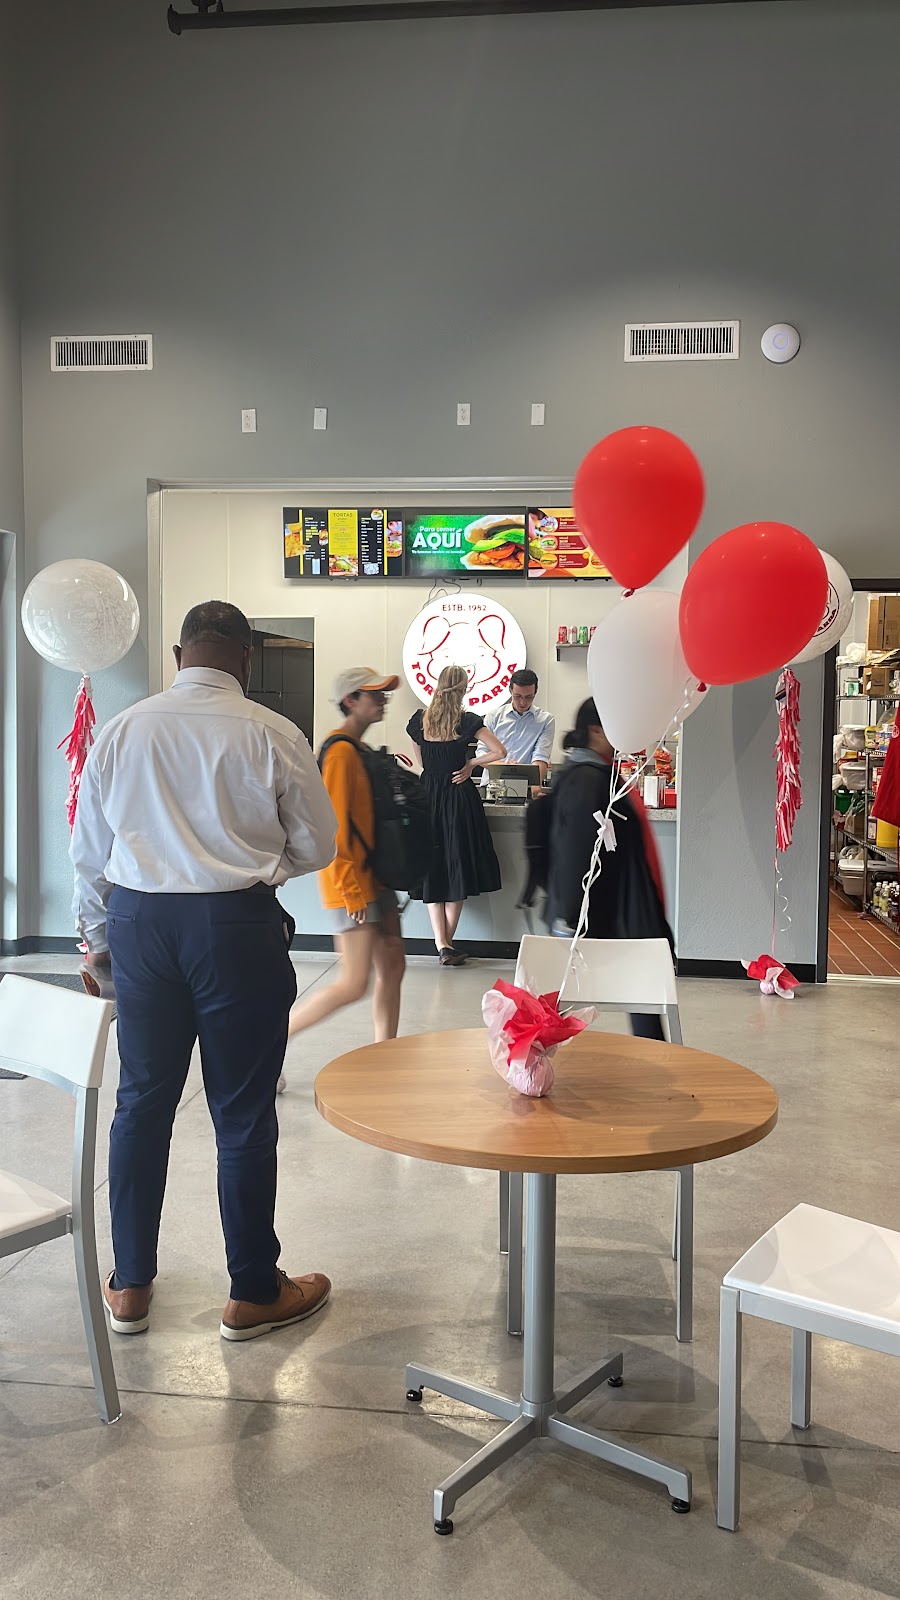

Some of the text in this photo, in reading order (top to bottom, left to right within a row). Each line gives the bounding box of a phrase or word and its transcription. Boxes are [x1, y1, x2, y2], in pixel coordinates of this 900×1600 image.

[412, 528, 463, 550] AQUÍ
[419, 525, 436, 533] Para
[442, 604, 487, 612] ESTB. 1982
[817, 608, 837, 632] ARRA
[411, 661, 518, 707] TOR PARRA
